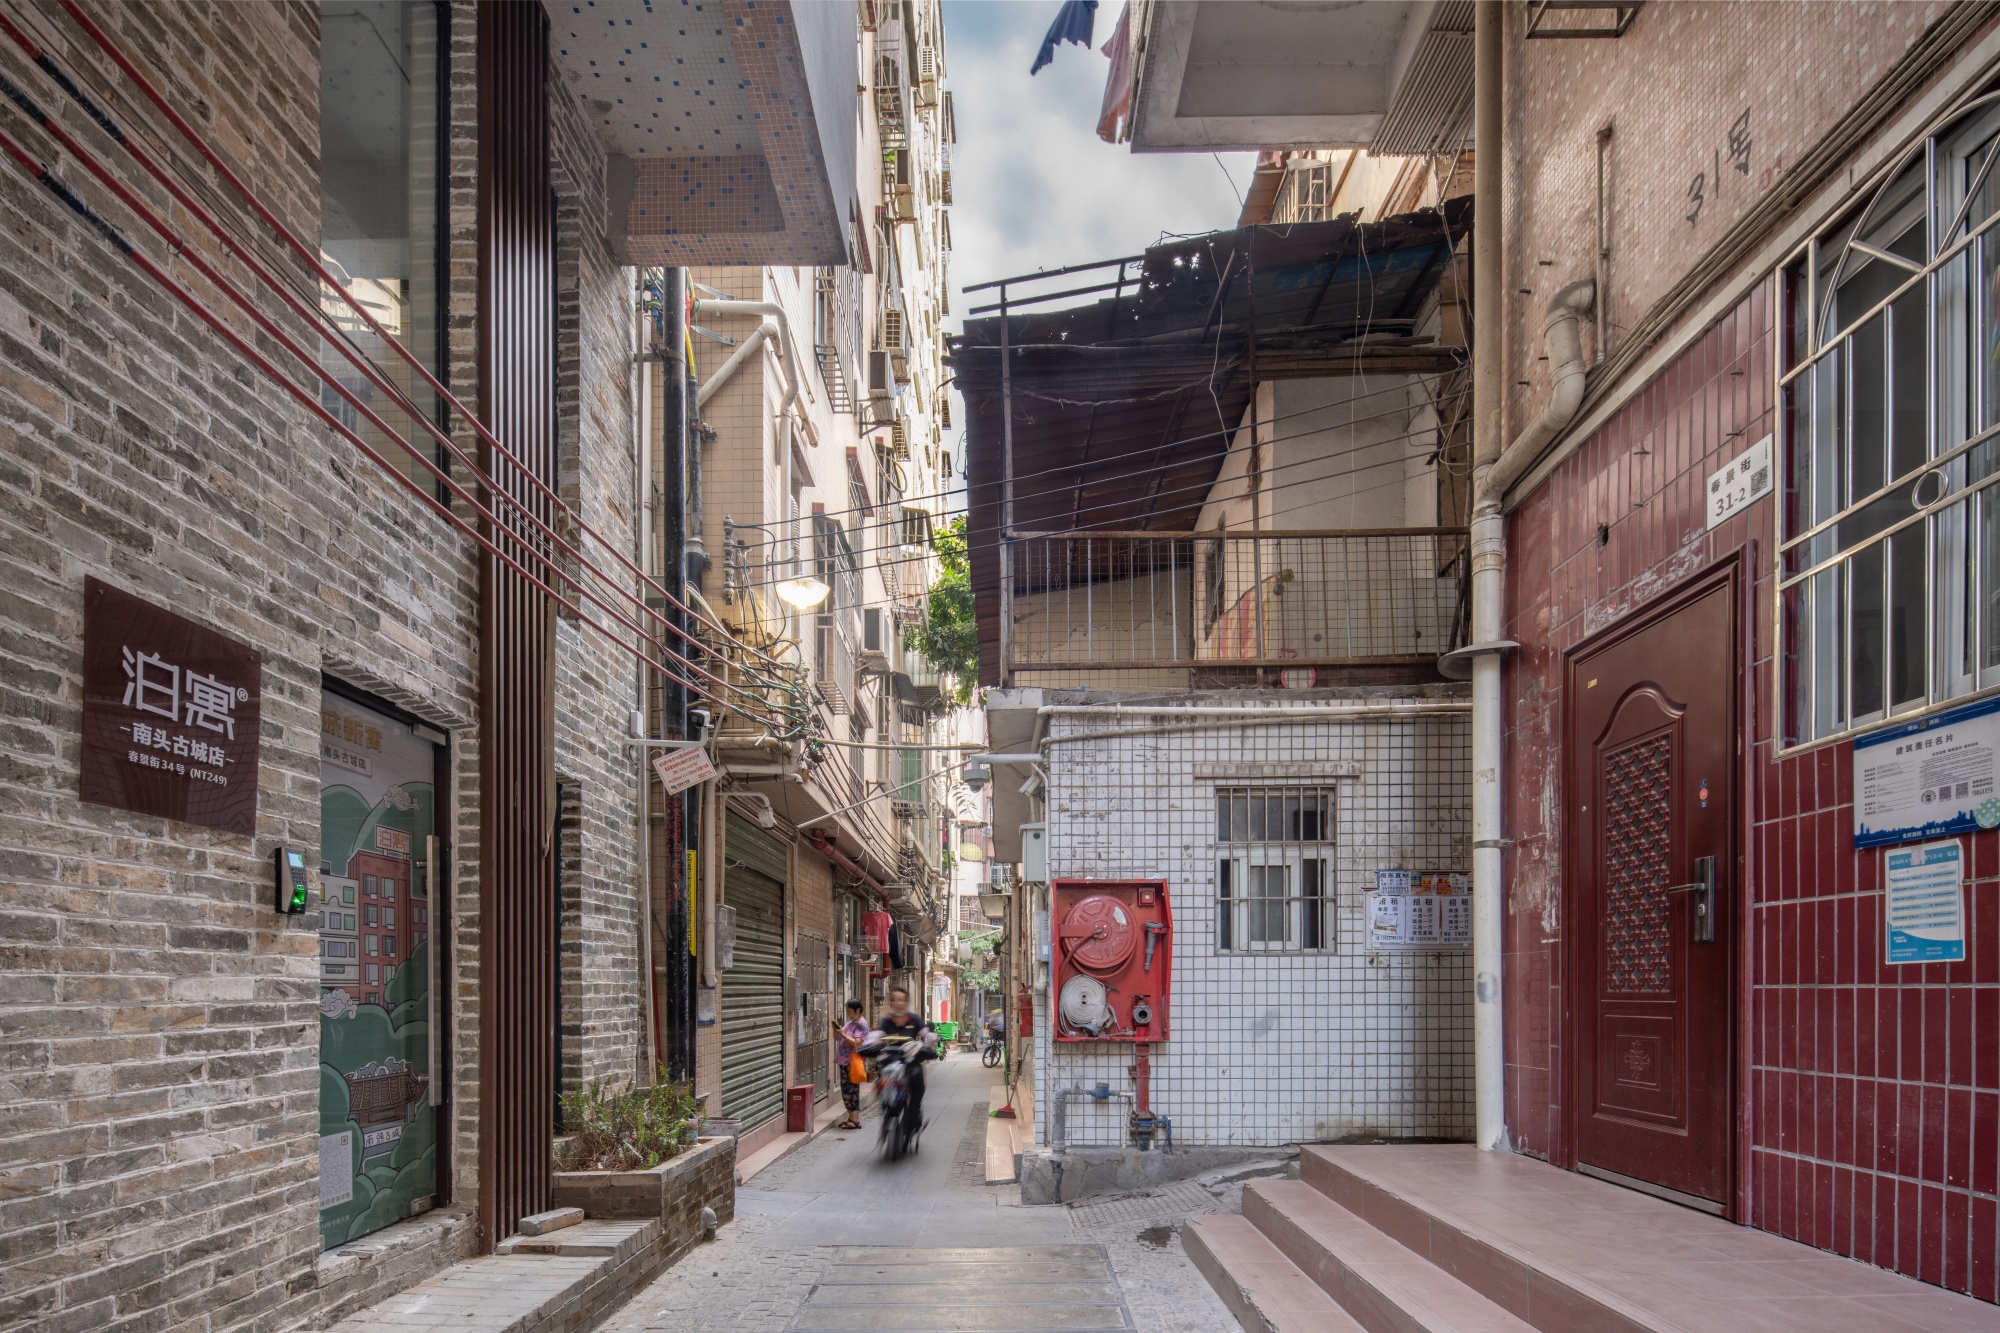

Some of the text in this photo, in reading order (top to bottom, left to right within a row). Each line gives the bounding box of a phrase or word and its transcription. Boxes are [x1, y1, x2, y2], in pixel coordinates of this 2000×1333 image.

[1686, 106, 1753, 229] 31号
[1711, 456, 1751, 494] 春景街
[1715, 487, 1746, 516] 31-2
[1896, 734, 1954, 755] 建筑责任名片
[320, 745, 366, 769] 南头古城店
[190, 769, 227, 787] (NT249)
[1972, 786, 1993, 796] 96119
[1413, 898, 1433, 906] 招租
[1449, 898, 1469, 906] 招租
